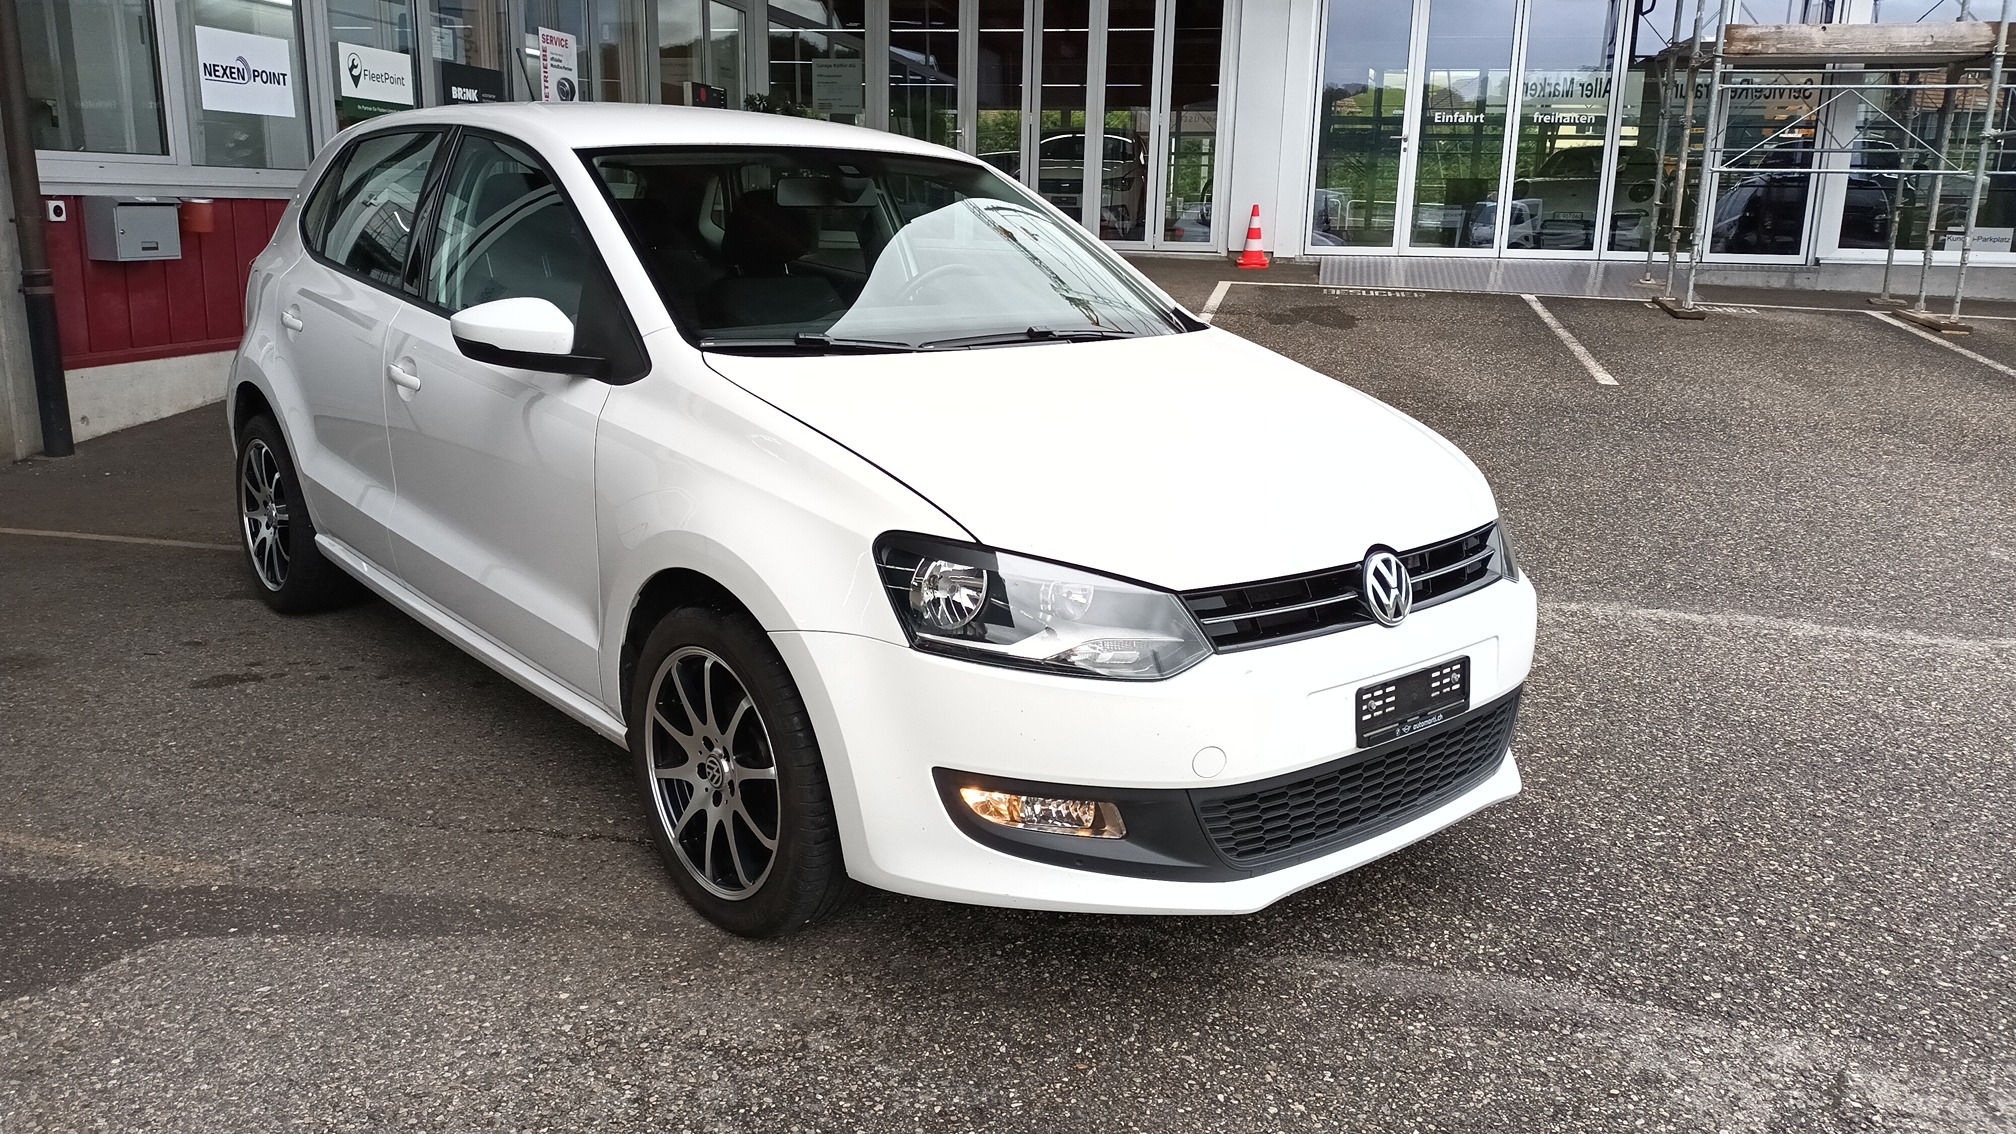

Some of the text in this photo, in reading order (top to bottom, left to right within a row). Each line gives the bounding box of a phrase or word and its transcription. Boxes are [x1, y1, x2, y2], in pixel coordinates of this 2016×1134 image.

[541, 33, 569, 49] SERVICE
[203, 62, 288, 87] NEXEN POINT
[363, 69, 406, 87] FleetPoint
[541, 46, 550, 101] ETRIEBE
[1434, 111, 1595, 124] Einfahrt freihalten
[1947, 235, 2011, 244] Kun-Parkplatz
